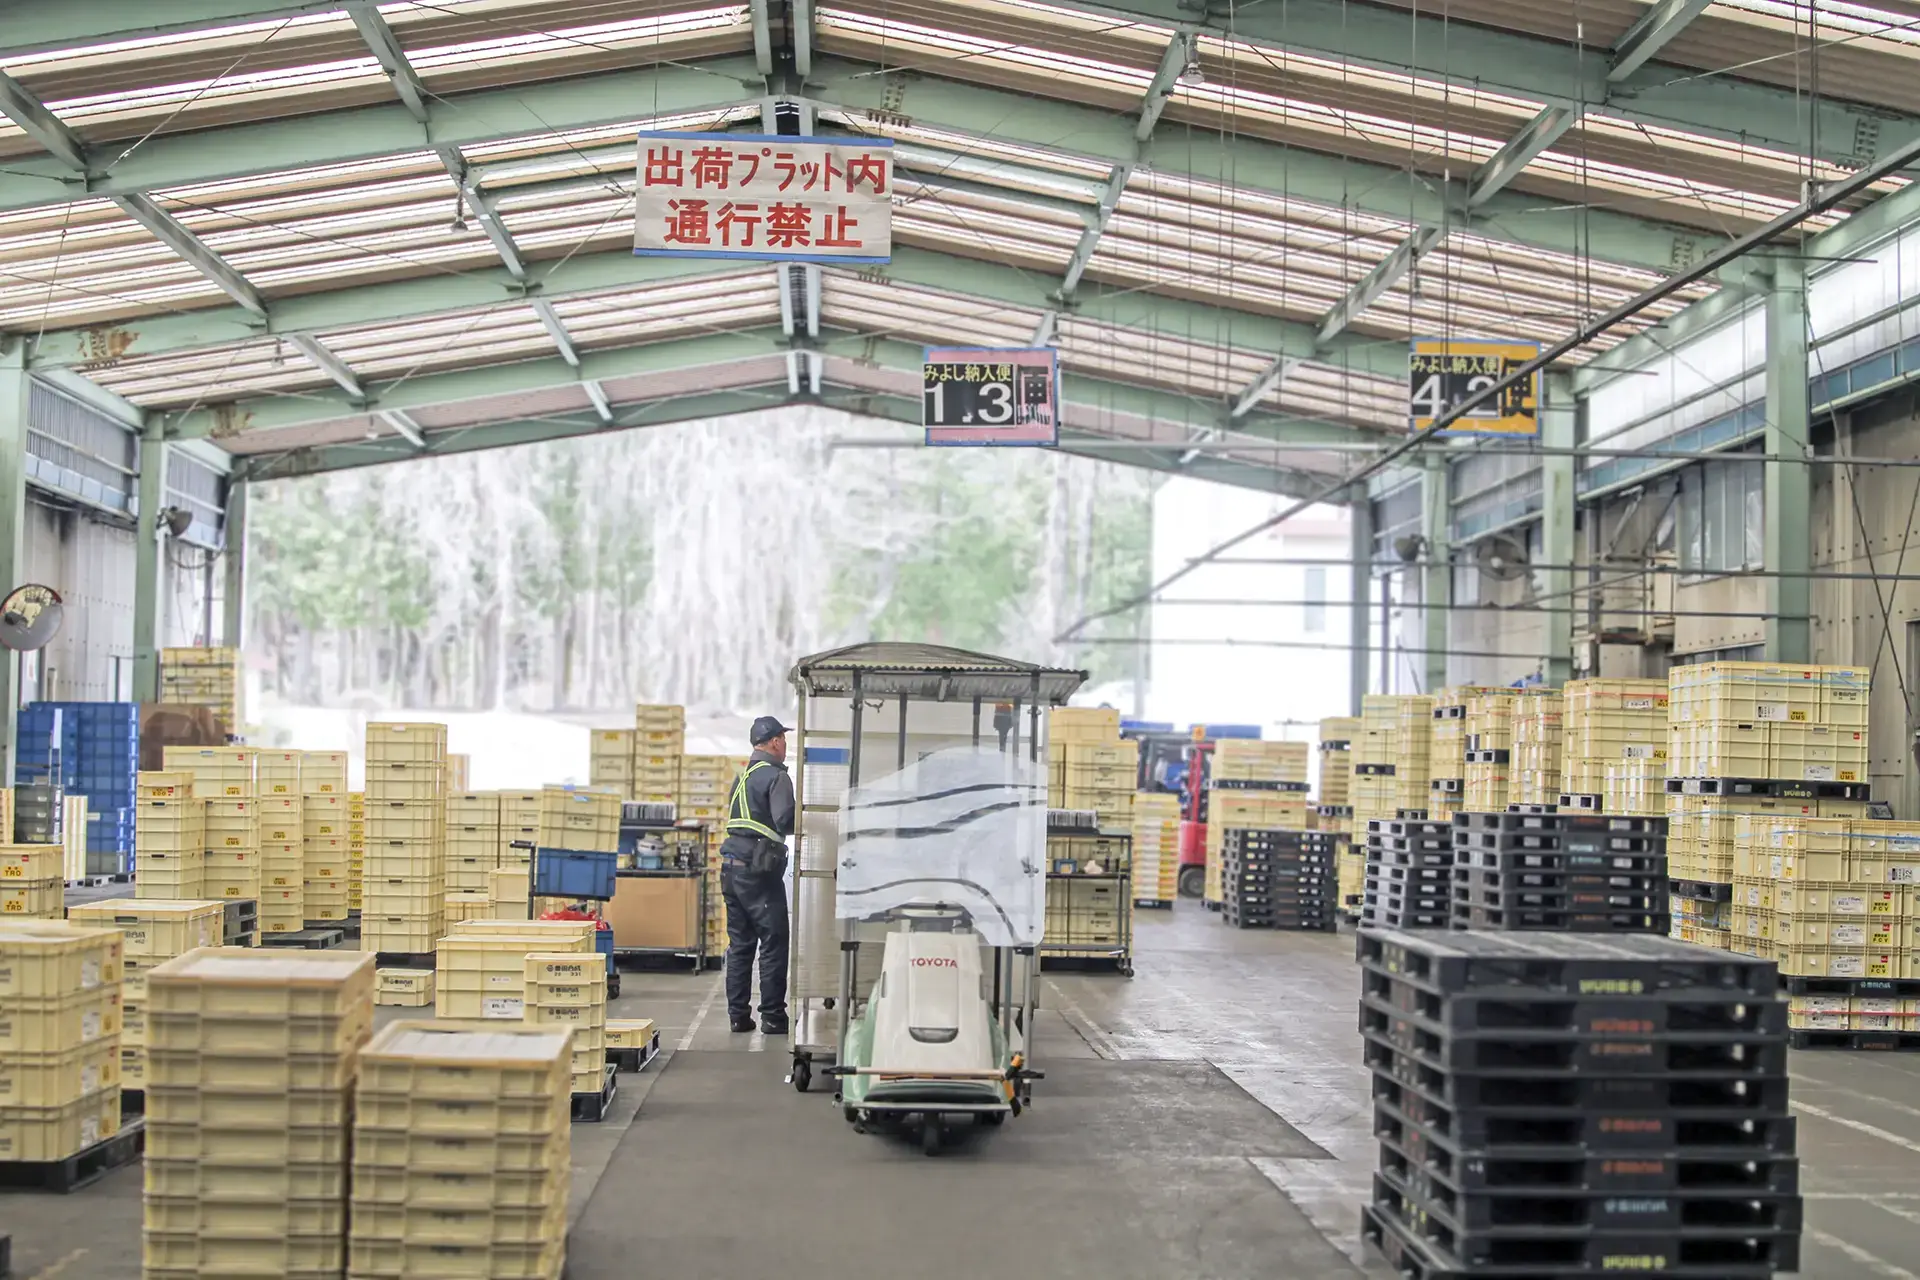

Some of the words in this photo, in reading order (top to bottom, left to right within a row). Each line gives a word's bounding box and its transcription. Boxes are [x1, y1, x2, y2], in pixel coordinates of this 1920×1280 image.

[644, 146, 886, 194] 出荷プラット内
[663, 198, 863, 248] 通行禁止
[924, 364, 1012, 382] みよし納入便
[910, 957, 958, 968] TOYOTA
